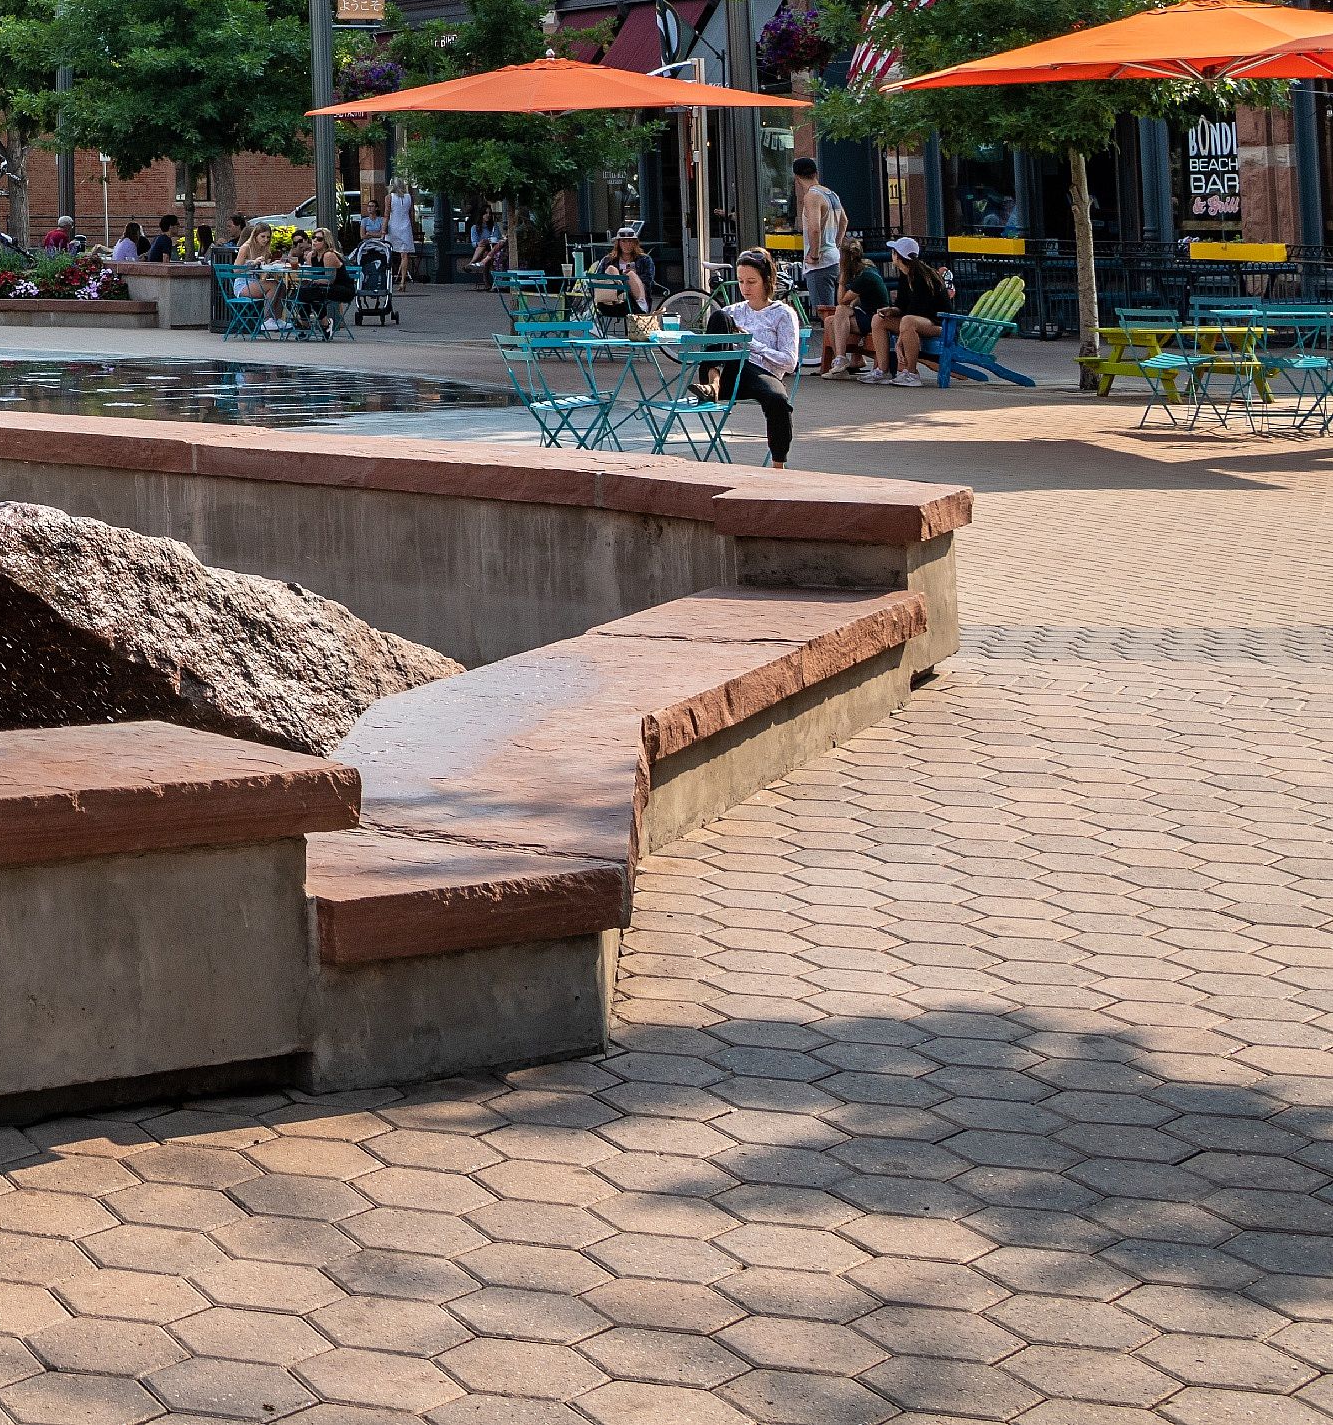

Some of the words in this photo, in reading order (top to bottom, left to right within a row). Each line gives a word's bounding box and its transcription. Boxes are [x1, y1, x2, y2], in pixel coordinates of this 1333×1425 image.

[339, 0, 383, 12] ようこそ
[1188, 115, 1238, 156] BONDI
[1189, 158, 1239, 171] BEACH
[1190, 173, 1240, 194] BAR
